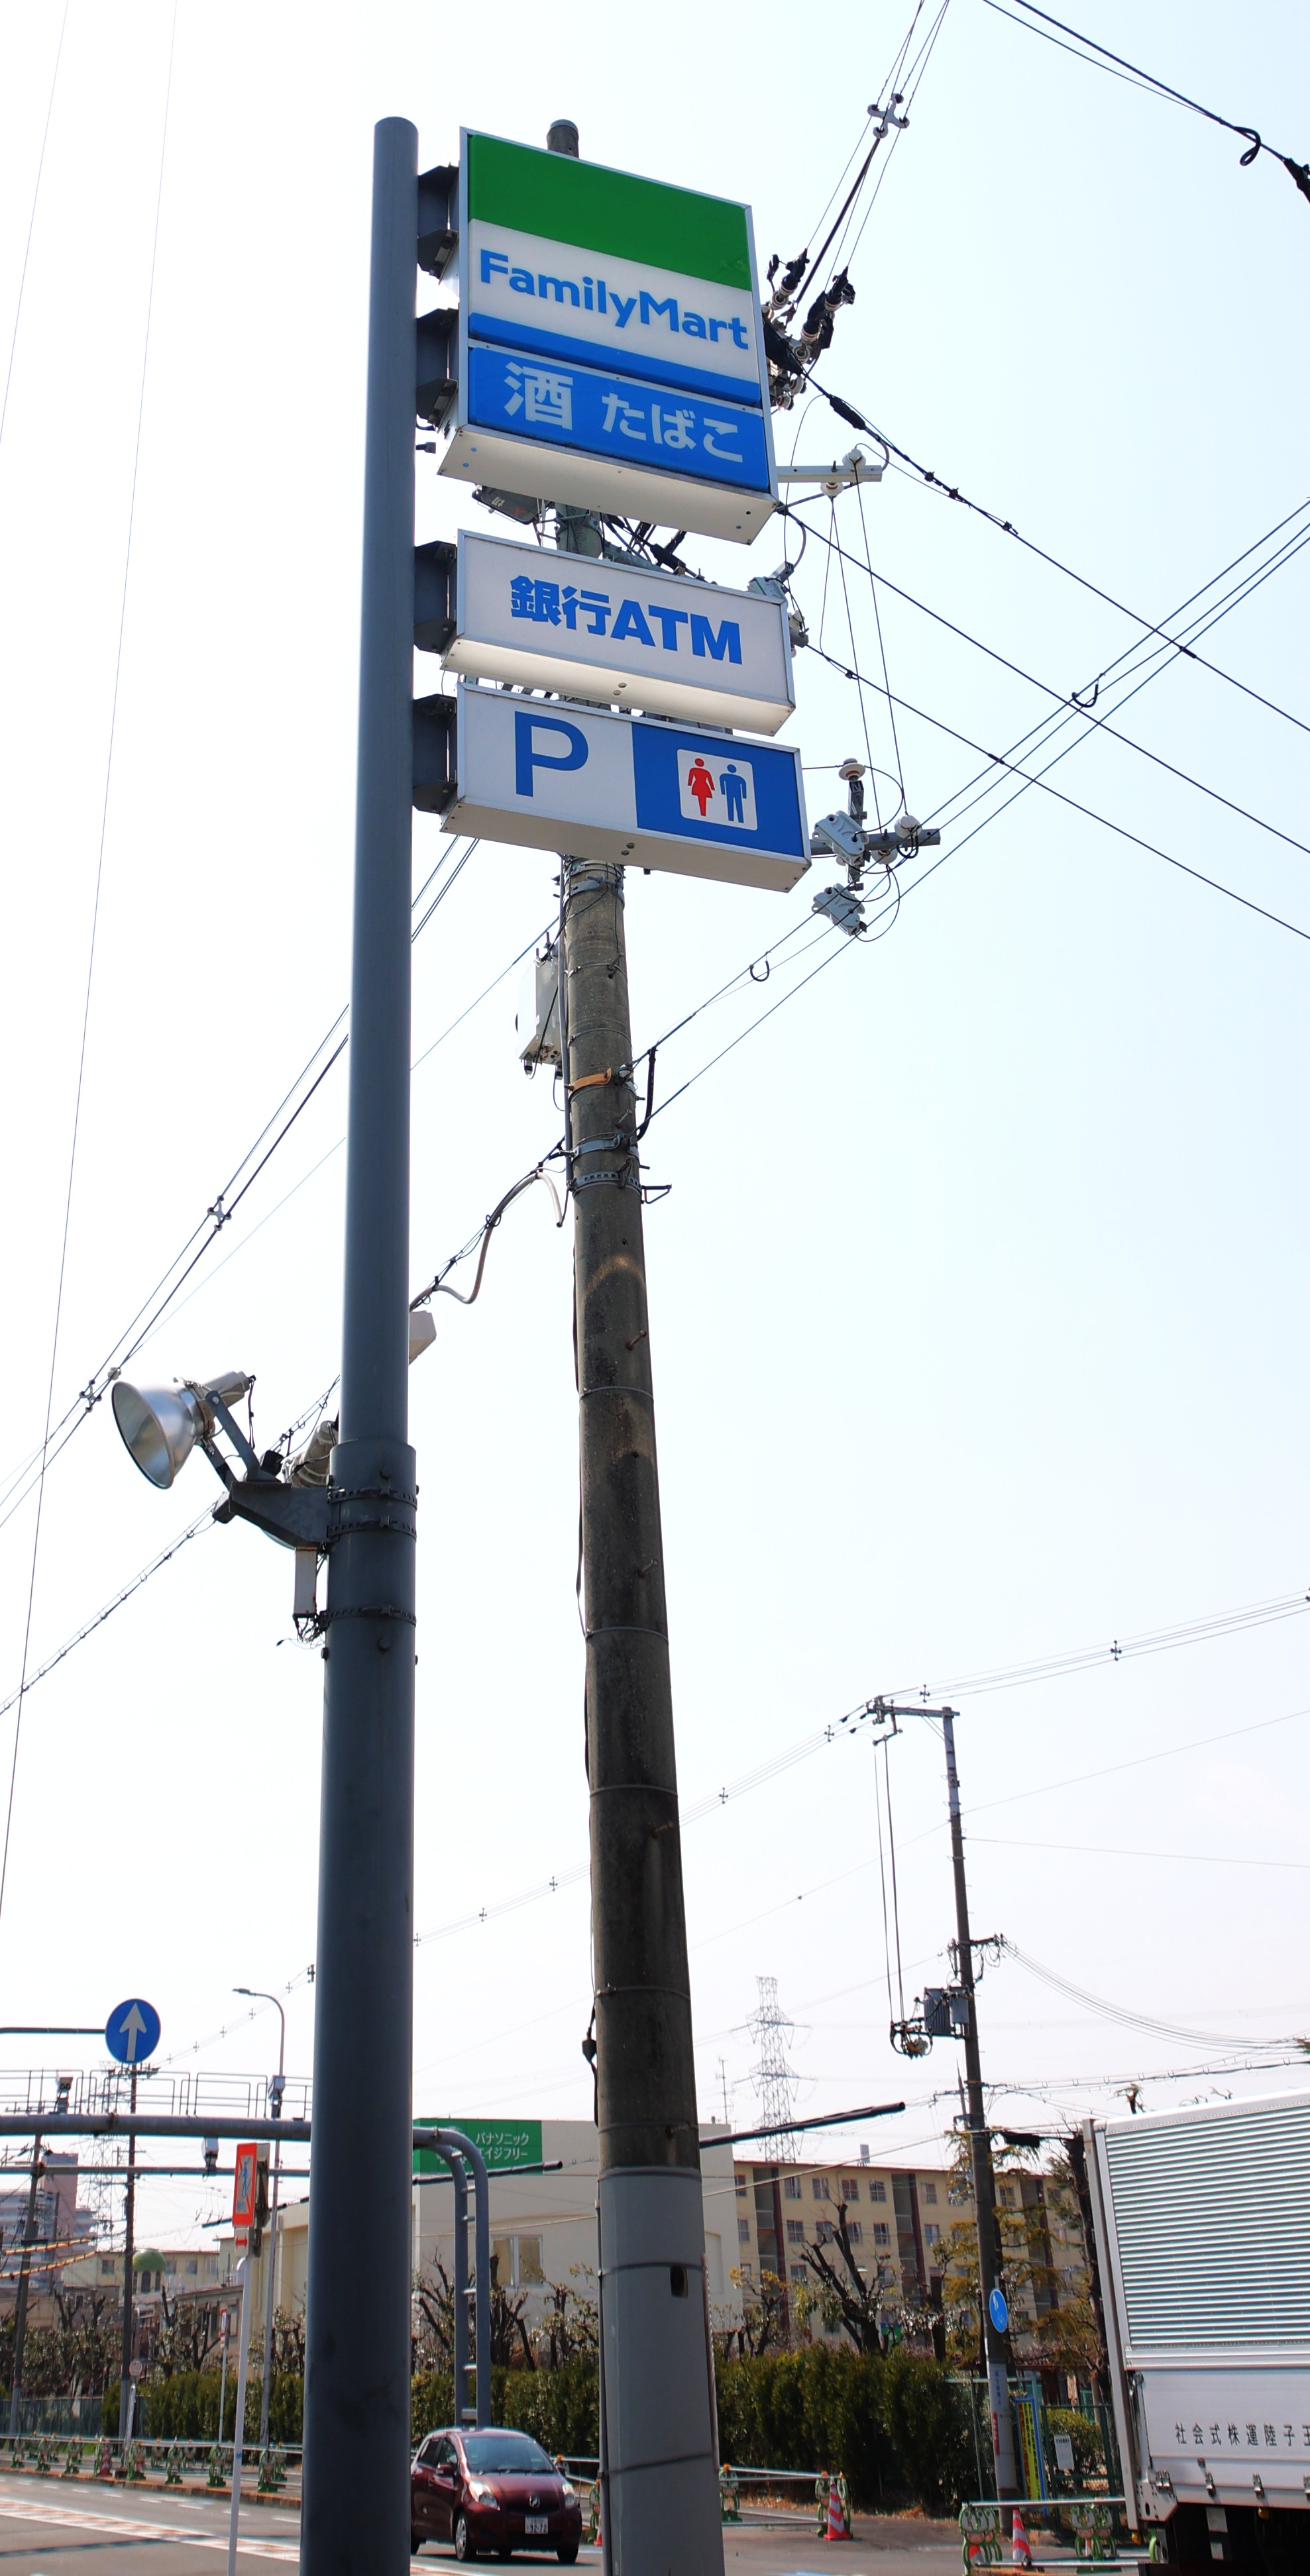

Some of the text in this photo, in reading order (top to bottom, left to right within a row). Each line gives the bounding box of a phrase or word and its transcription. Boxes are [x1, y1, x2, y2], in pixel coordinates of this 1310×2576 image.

[480, 248, 749, 350] FamilyMart
[504, 362, 743, 463] 酒 たばこ
[510, 575, 743, 665] 銀行ATM
[514, 711, 589, 798] P
[476, 2132, 529, 2146] パナソニック
